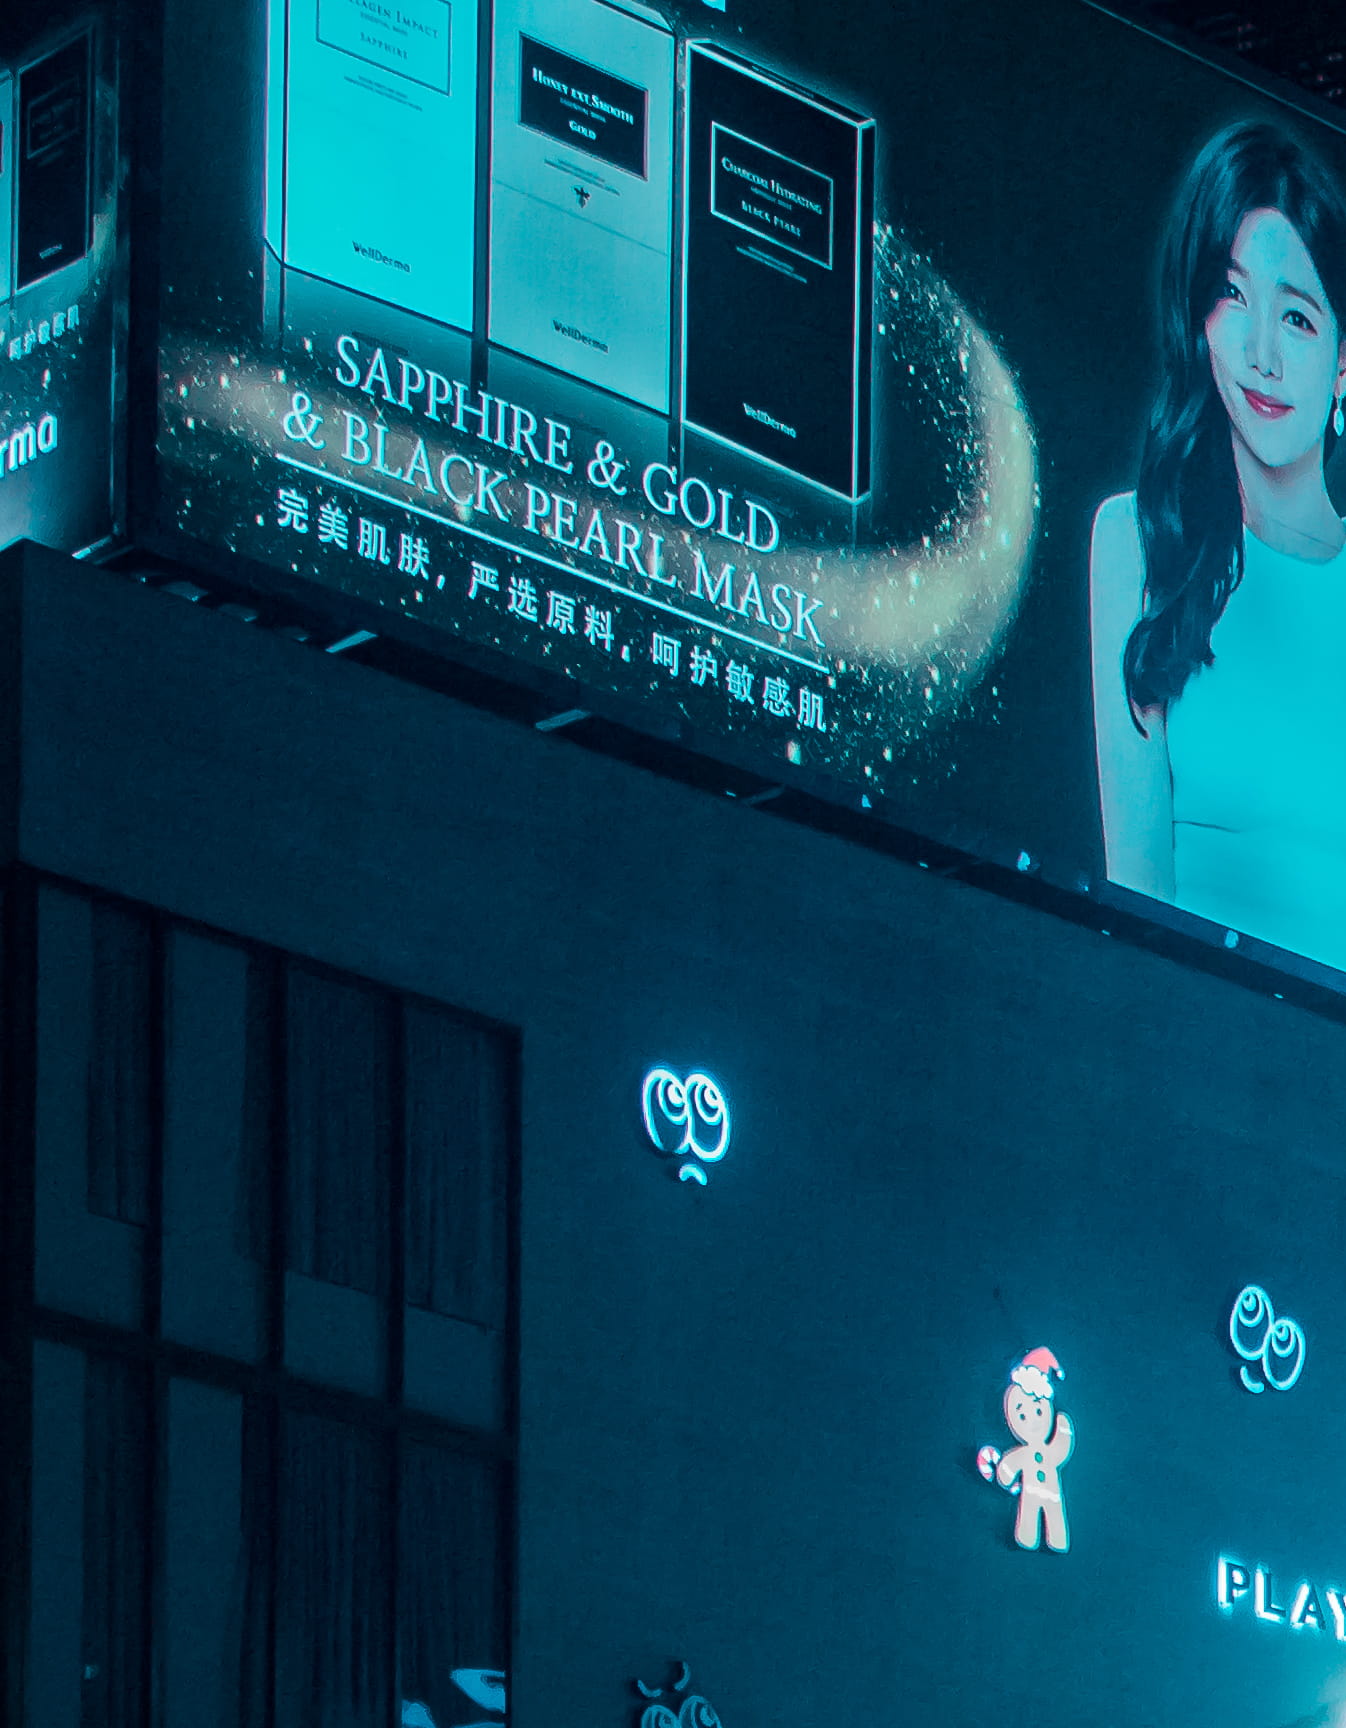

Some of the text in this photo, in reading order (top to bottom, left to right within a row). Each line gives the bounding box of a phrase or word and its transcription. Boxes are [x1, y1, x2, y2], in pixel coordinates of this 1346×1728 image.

[352, 240, 411, 274] WellDerma
[552, 319, 609, 355] WellDerma
[742, 402, 798, 439] WellDerma
[336, 334, 780, 553] SAPPHIRE & GOLD
[282, 392, 826, 648] & BLACK PEARL MASK
